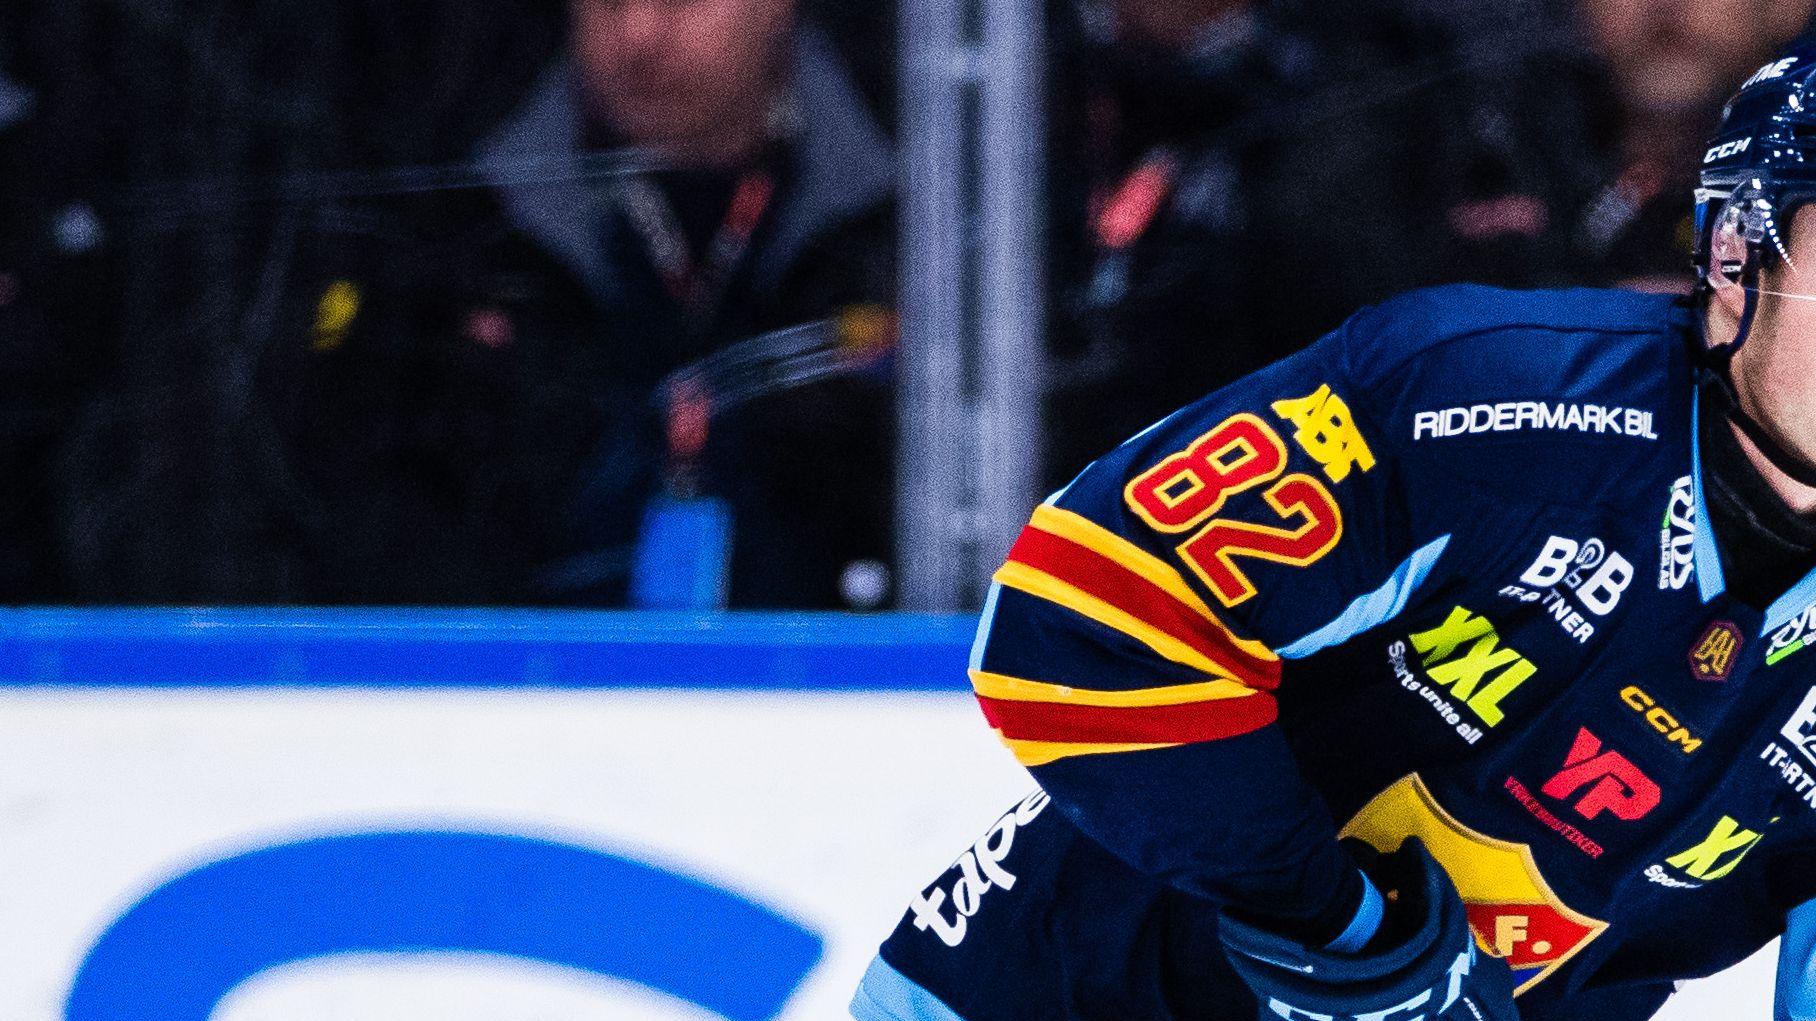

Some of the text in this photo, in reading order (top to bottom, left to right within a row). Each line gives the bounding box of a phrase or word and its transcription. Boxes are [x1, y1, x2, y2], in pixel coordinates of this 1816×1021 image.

[1704, 136, 1752, 164] CCM
[1123, 412, 1344, 608] 82
[1408, 604, 1539, 729] XXL
[1418, 685, 1460, 725] unite
[1455, 722, 1484, 745] all
[1619, 685, 1702, 755] CCM
[1540, 725, 1662, 821] YP
